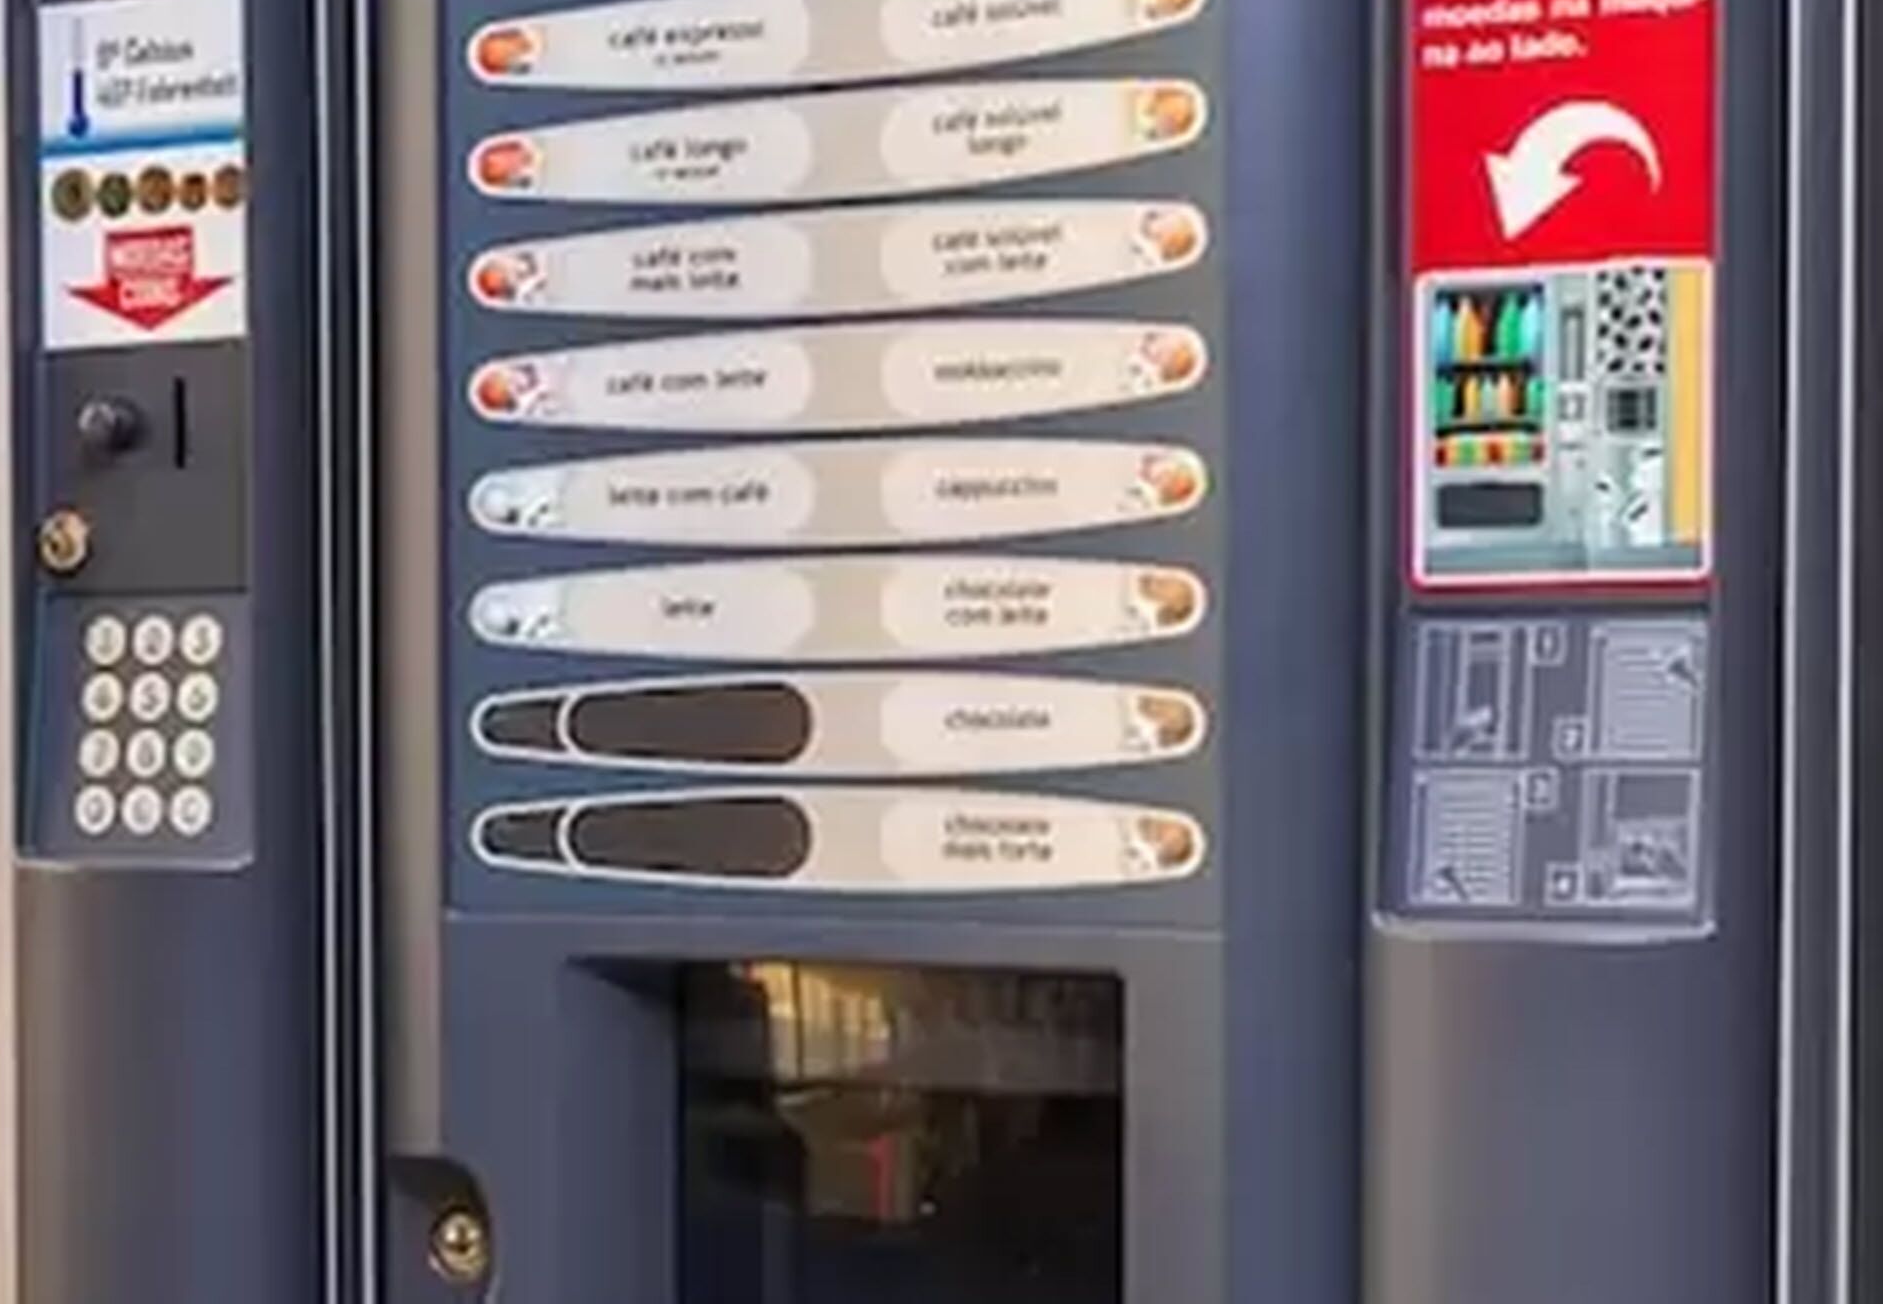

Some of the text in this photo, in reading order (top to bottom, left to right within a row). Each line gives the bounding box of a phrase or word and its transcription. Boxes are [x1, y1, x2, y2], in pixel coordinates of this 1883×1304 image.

[609, 23, 658, 50] café
[1422, 28, 1588, 69] na ao lado.
[931, 106, 979, 136] café
[628, 137, 678, 163] café
[632, 246, 682, 269] café
[606, 371, 656, 396] café
[660, 372, 710, 392] com
